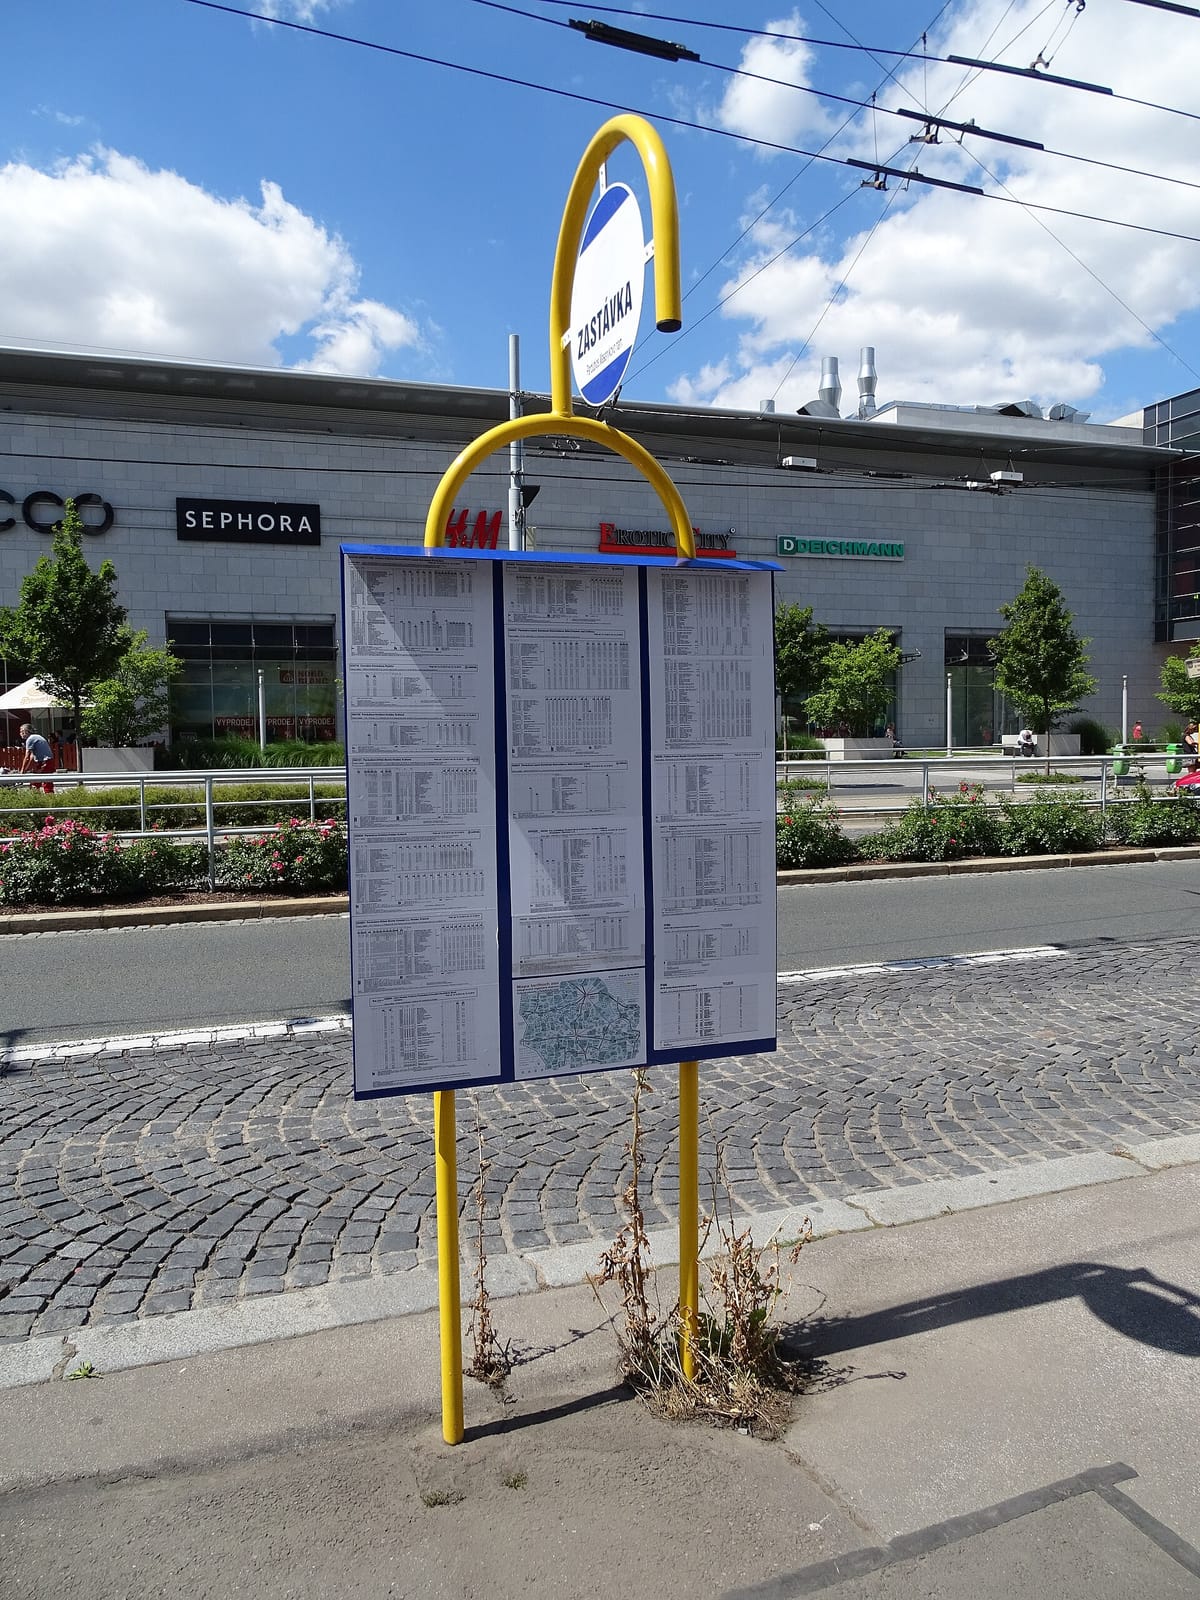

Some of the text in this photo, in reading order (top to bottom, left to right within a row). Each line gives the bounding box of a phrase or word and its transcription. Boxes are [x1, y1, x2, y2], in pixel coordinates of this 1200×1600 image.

[577, 280, 633, 361] ZASTÁVKA
[185, 510, 313, 533] SEPHORA
[444, 508, 503, 550] H&M
[797, 539, 904, 557] DEICHMANN
